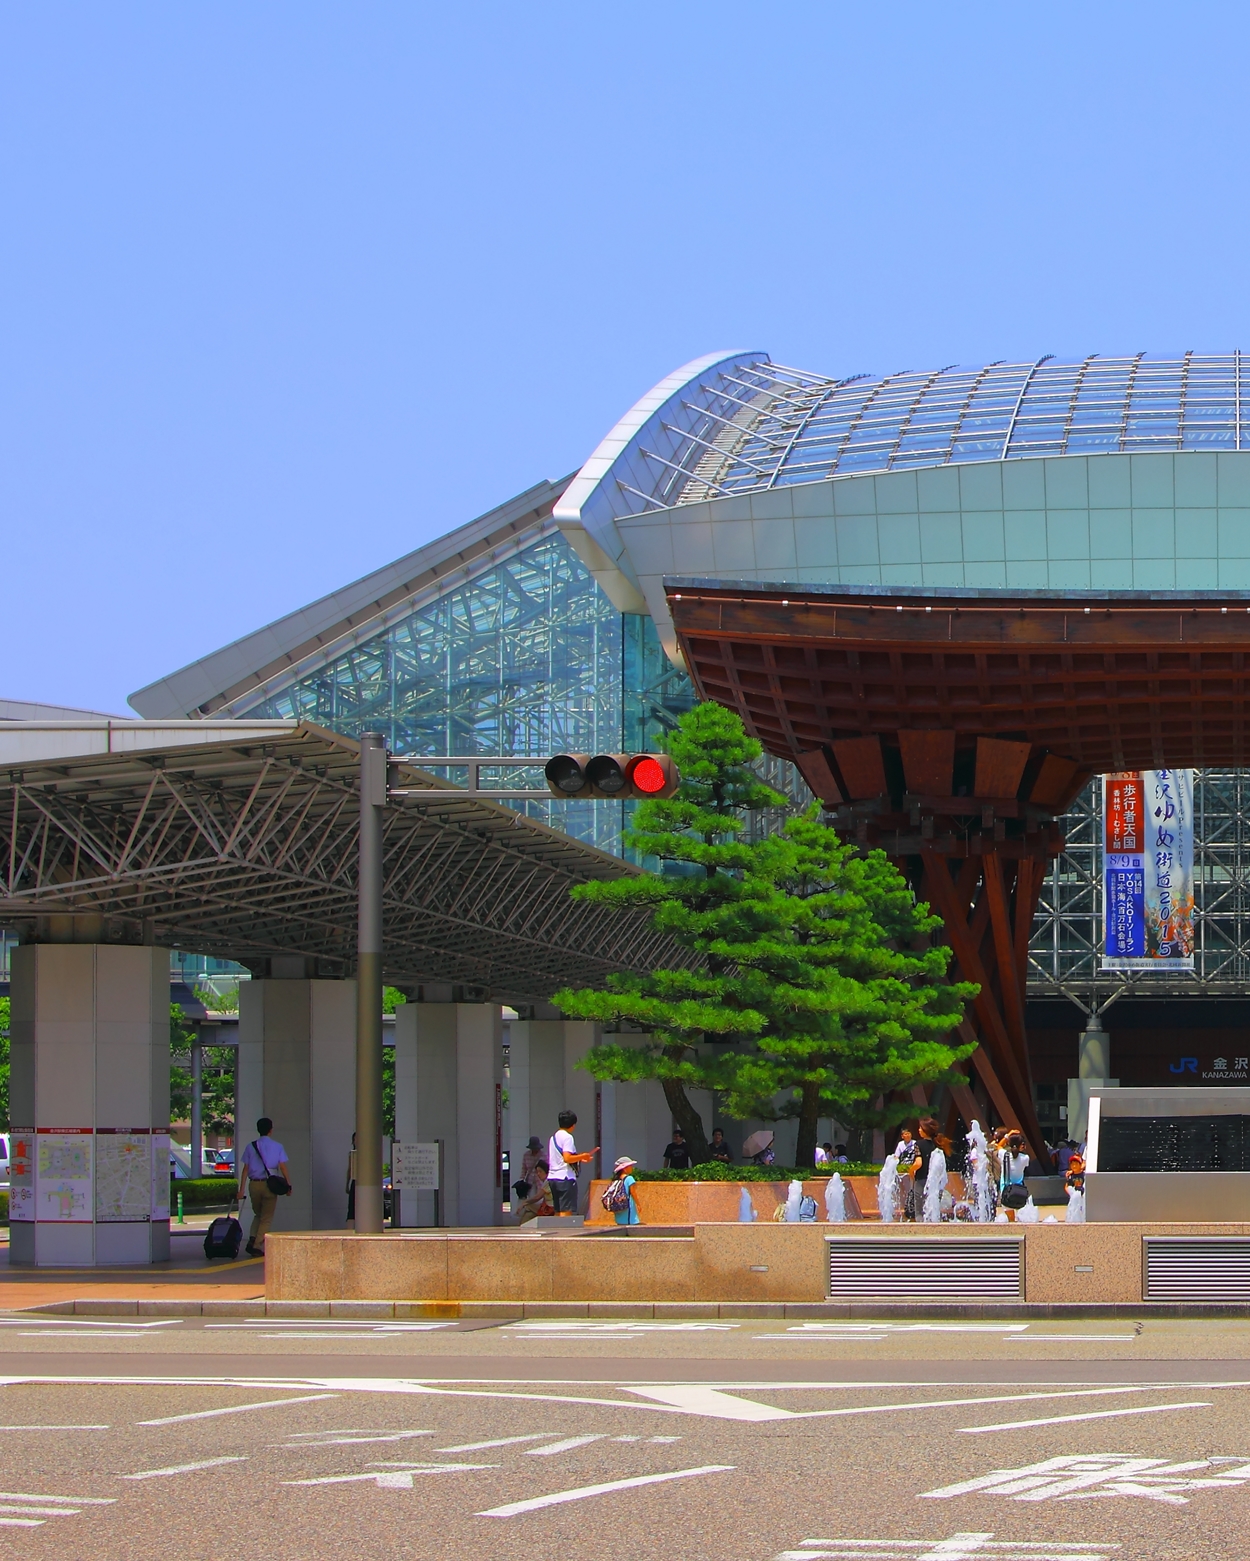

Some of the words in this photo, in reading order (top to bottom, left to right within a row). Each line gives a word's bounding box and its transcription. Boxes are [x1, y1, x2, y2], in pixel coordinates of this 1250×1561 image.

[1123, 784, 1136, 849] 歩行者天国
[1126, 873, 1134, 953] YOSAKOIソーラン
[1169, 1057, 1199, 1073] JR
[1202, 1071, 1247, 1079] KANAZAWA
